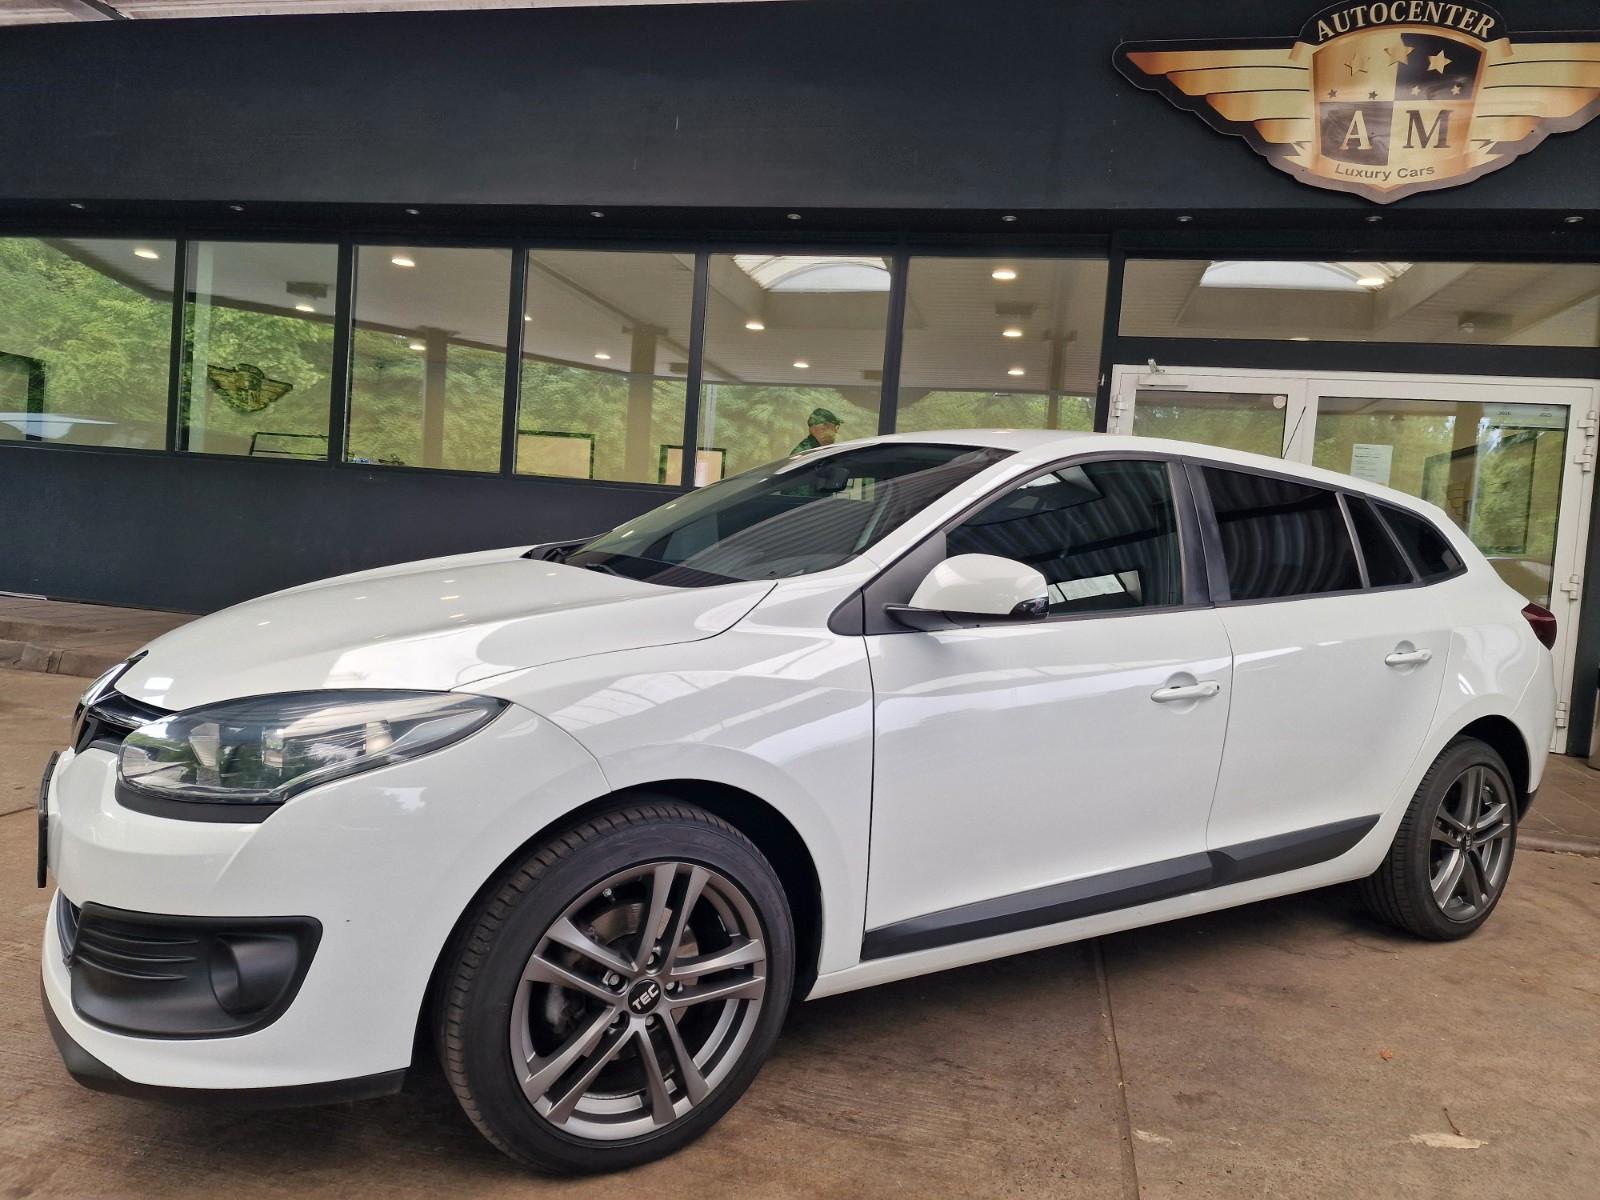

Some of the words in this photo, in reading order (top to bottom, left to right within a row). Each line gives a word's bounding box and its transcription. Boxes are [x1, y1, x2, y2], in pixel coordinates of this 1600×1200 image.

[1317, 1, 1496, 42] AUTOCENTER
[1340, 110, 1372, 150] A
[1402, 109, 1454, 149] M
[1335, 163, 1391, 181] Luxury
[1397, 165, 1435, 179] Cars
[632, 983, 659, 1010] TEC
